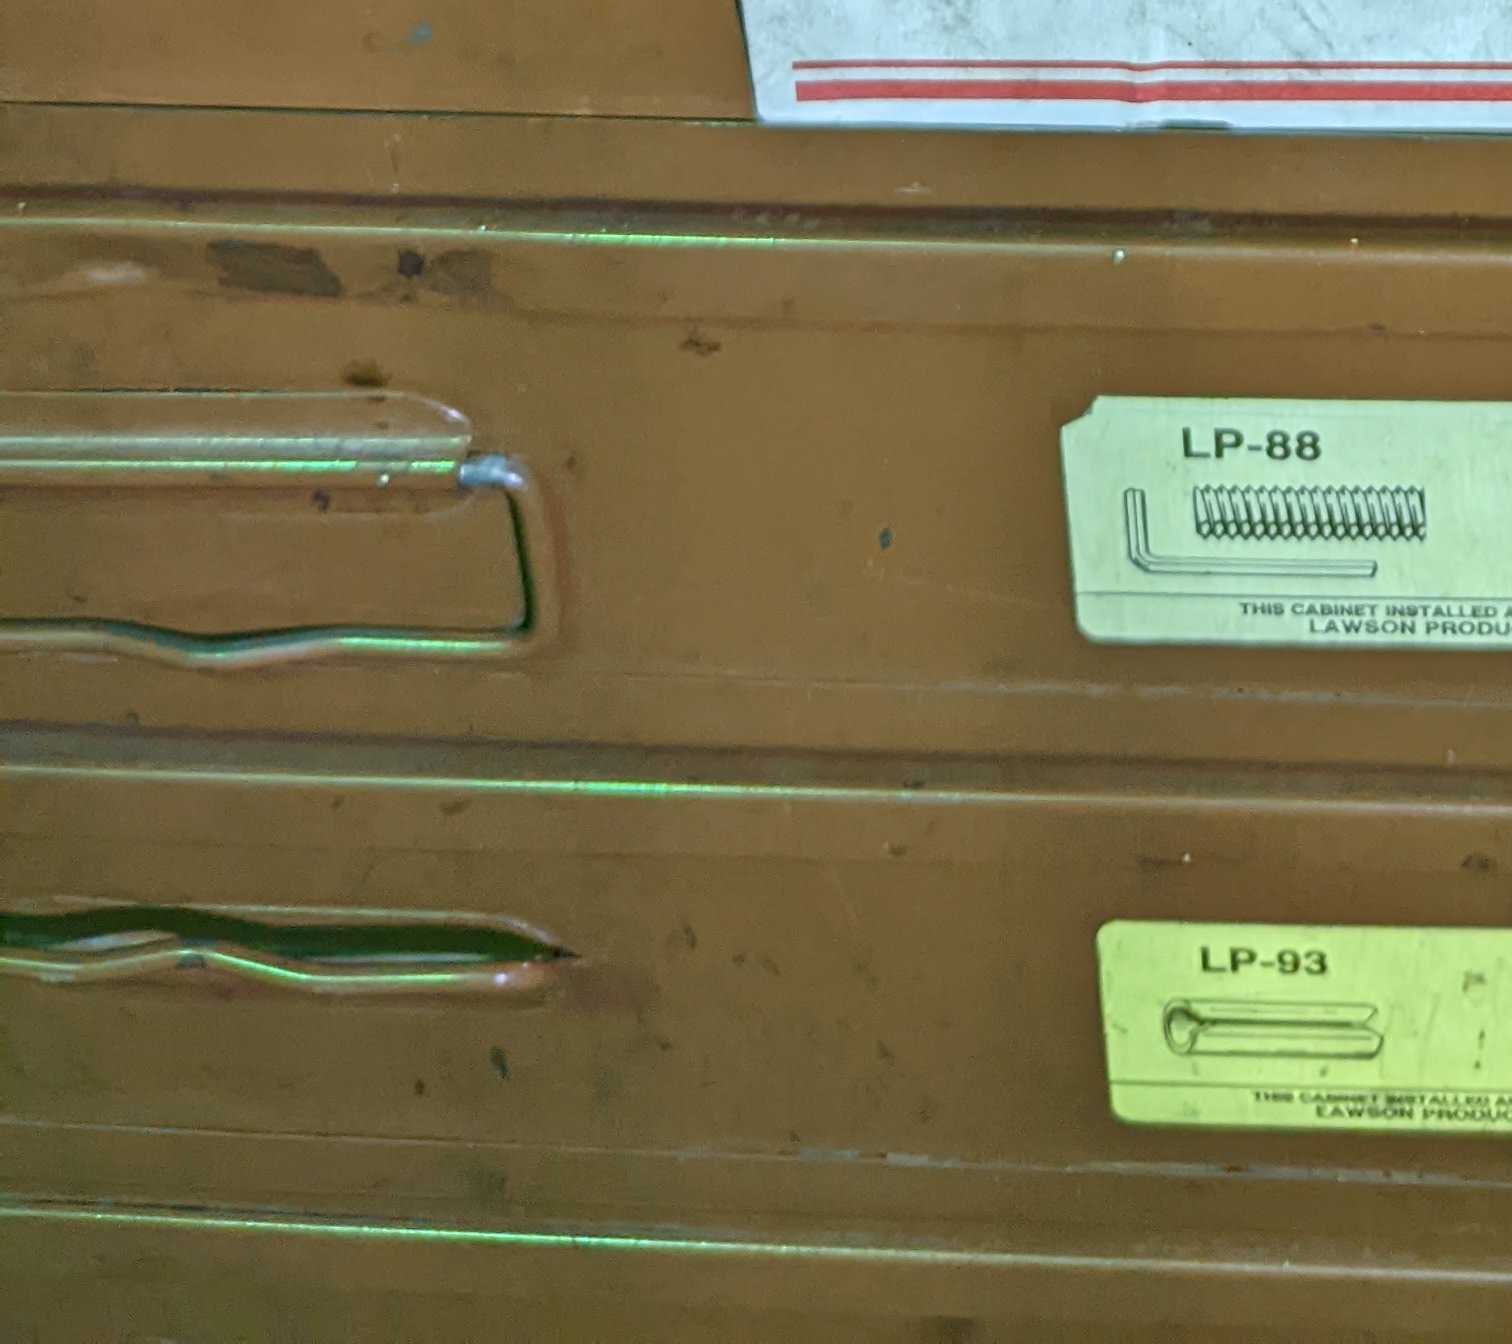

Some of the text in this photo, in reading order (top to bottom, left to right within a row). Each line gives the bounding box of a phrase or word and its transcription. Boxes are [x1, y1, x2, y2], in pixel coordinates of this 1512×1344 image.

[1182, 427, 1322, 462] LP-88
[1240, 601, 1286, 616] THIS
[1291, 601, 1379, 617] CABINET
[1386, 603, 1498, 618] INSTALLED
[1309, 618, 1417, 634] LAWSON
[1200, 945, 1329, 976] LP-93
